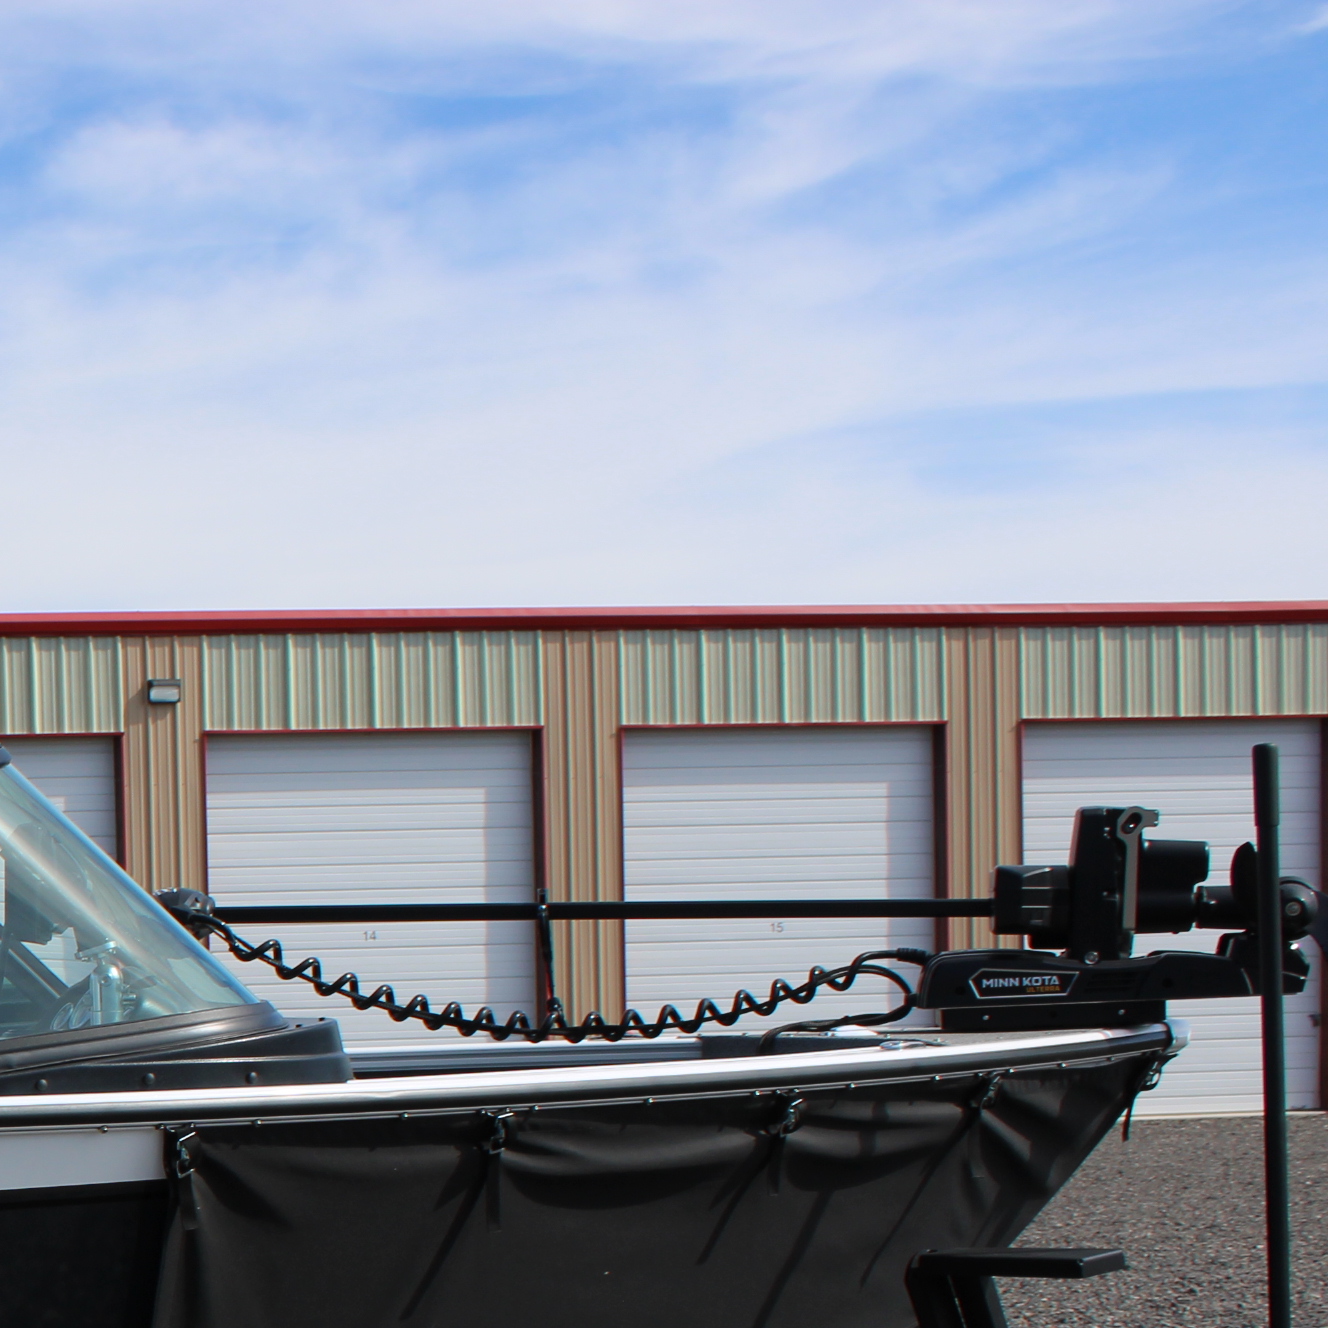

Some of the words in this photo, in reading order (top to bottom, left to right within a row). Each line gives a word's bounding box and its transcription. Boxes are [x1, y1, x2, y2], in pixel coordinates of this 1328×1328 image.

[770, 921, 784, 933] 15
[362, 930, 377, 941] 14
[981, 977, 1020, 988] MINN
[1022, 975, 1060, 987] KOTA
[1026, 985, 1061, 993] ULTERRA
